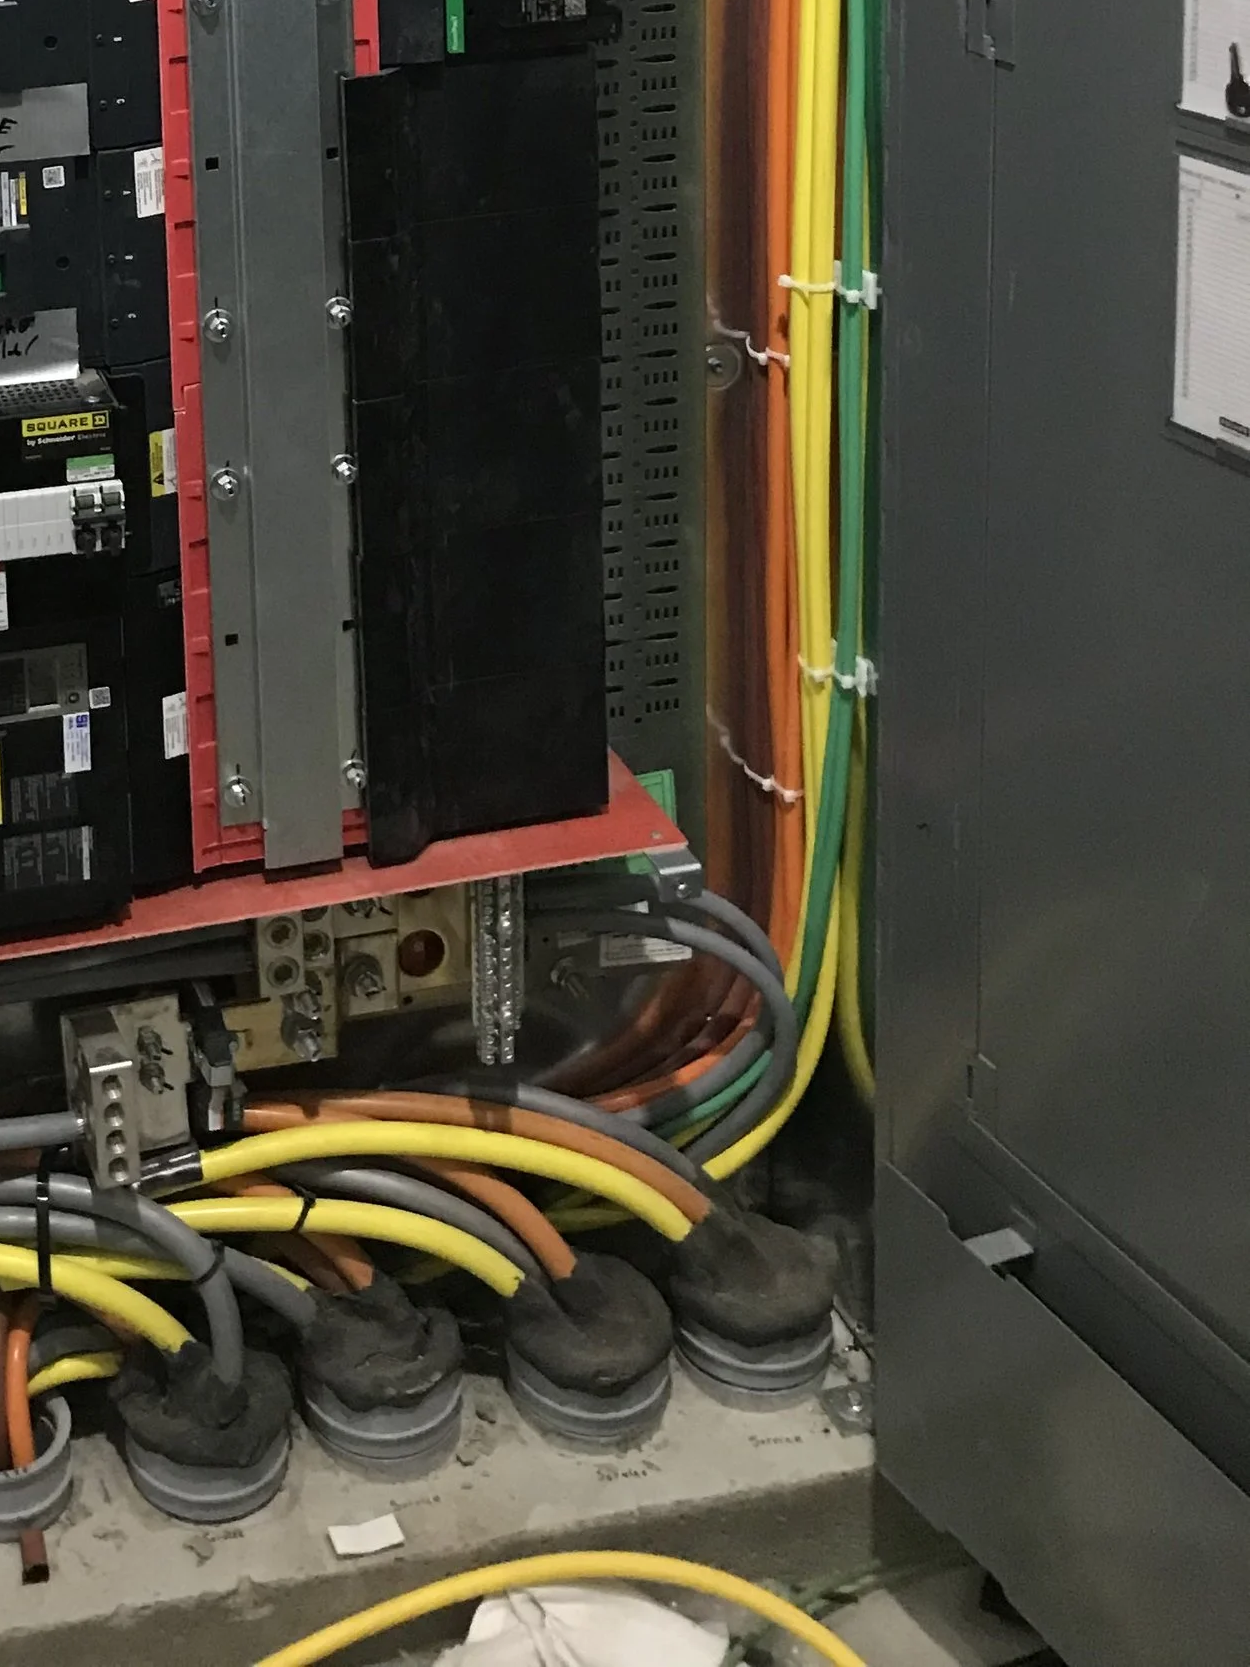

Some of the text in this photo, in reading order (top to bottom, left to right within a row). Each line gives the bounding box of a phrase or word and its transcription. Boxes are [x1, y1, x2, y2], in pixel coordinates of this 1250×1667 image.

[26, 417, 89, 433] SQUARE
[26, 438, 36, 447] by
[37, 434, 76, 445] Schneider
